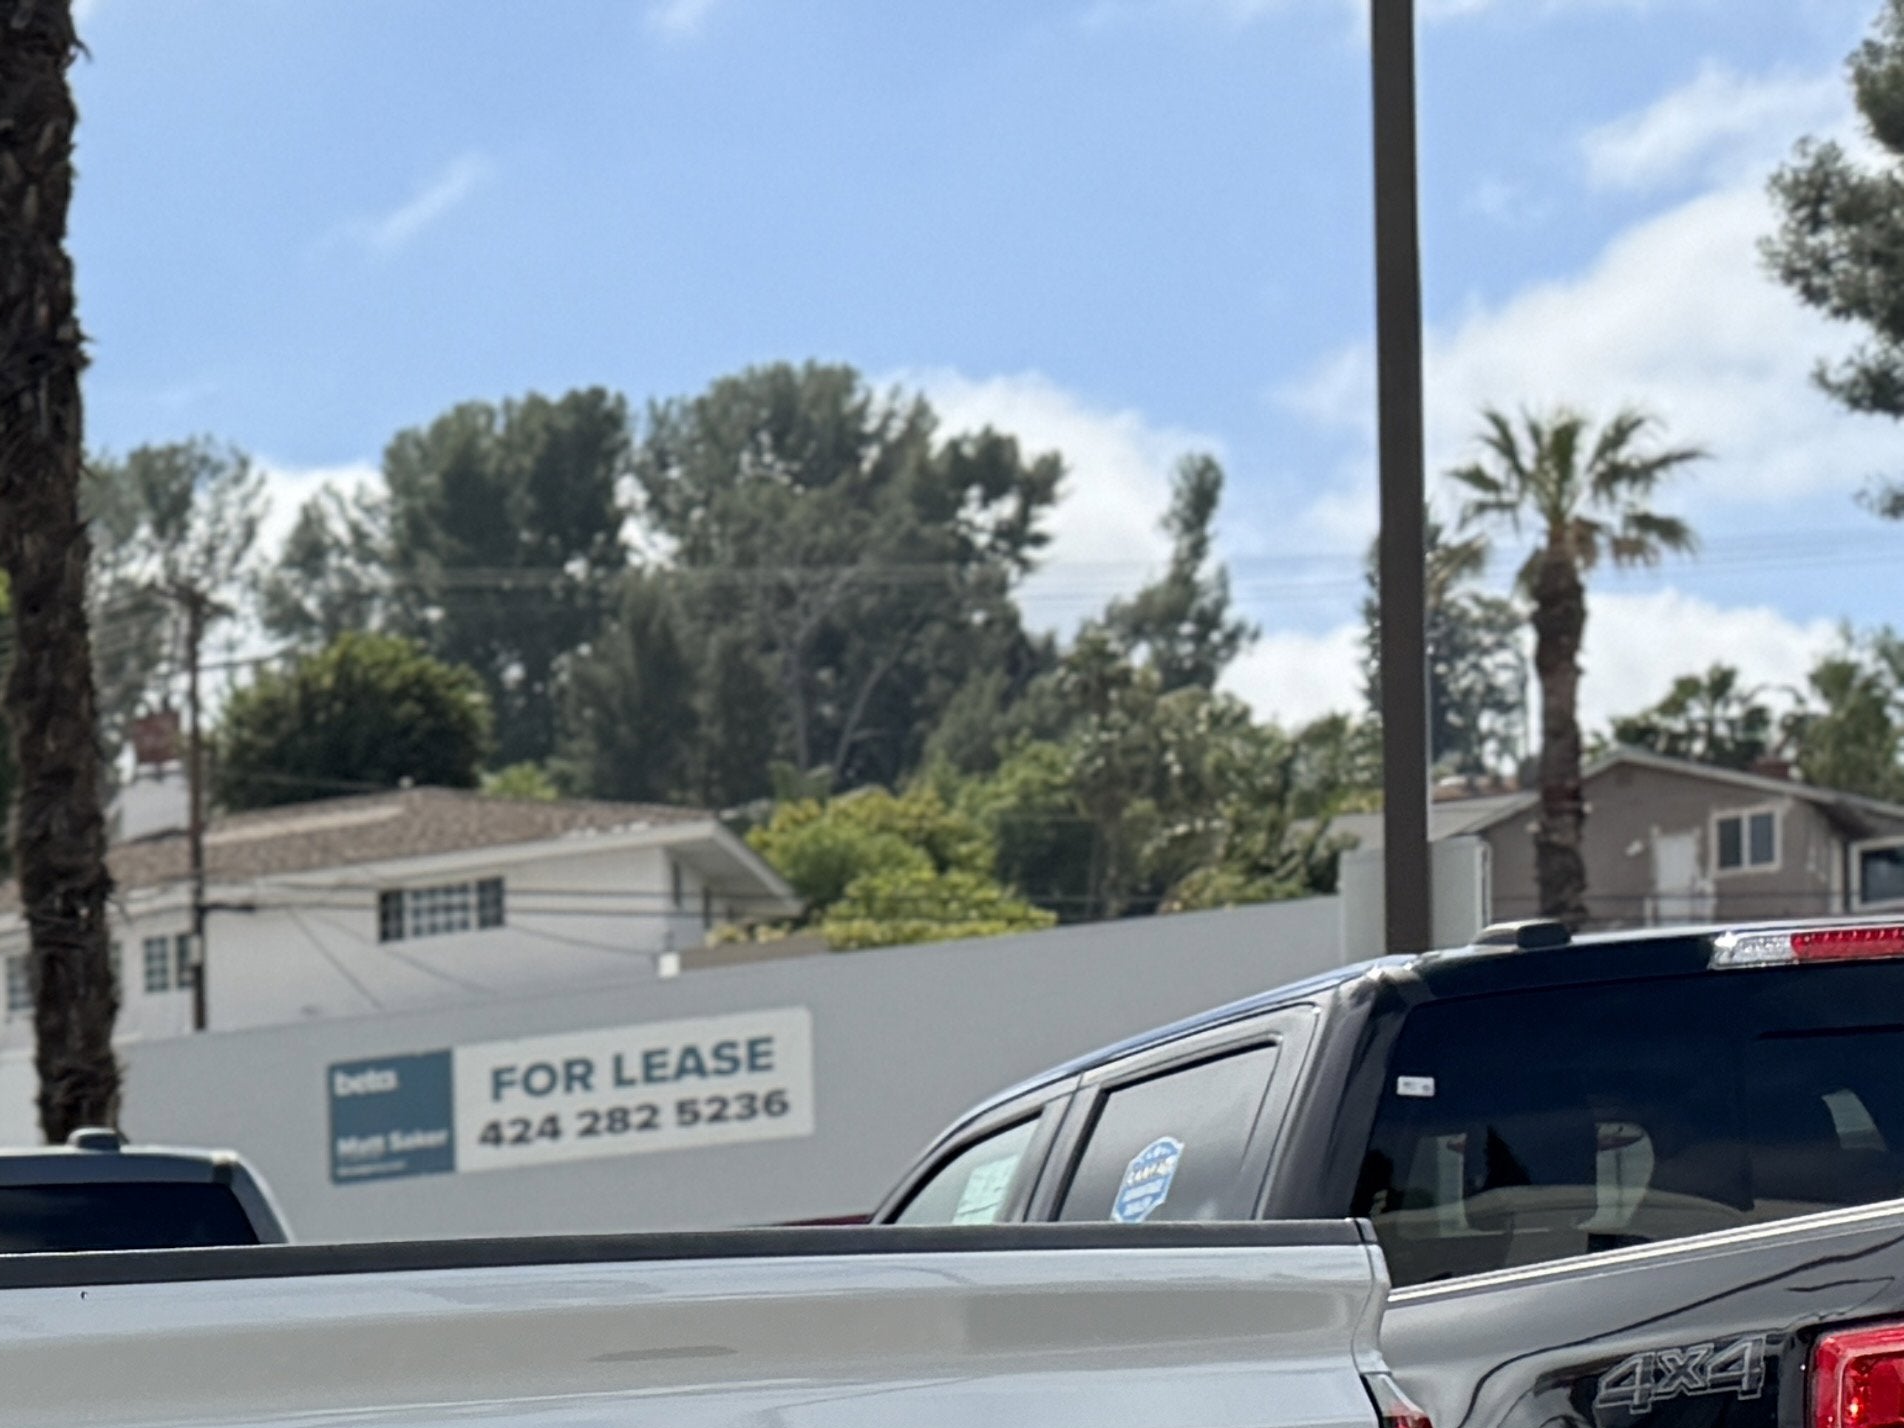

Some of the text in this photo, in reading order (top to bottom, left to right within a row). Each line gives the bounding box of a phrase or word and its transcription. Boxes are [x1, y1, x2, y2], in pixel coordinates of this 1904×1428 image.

[491, 1035, 775, 1102] FOR LEASE
[478, 1088, 790, 1148] 424 282 5236
